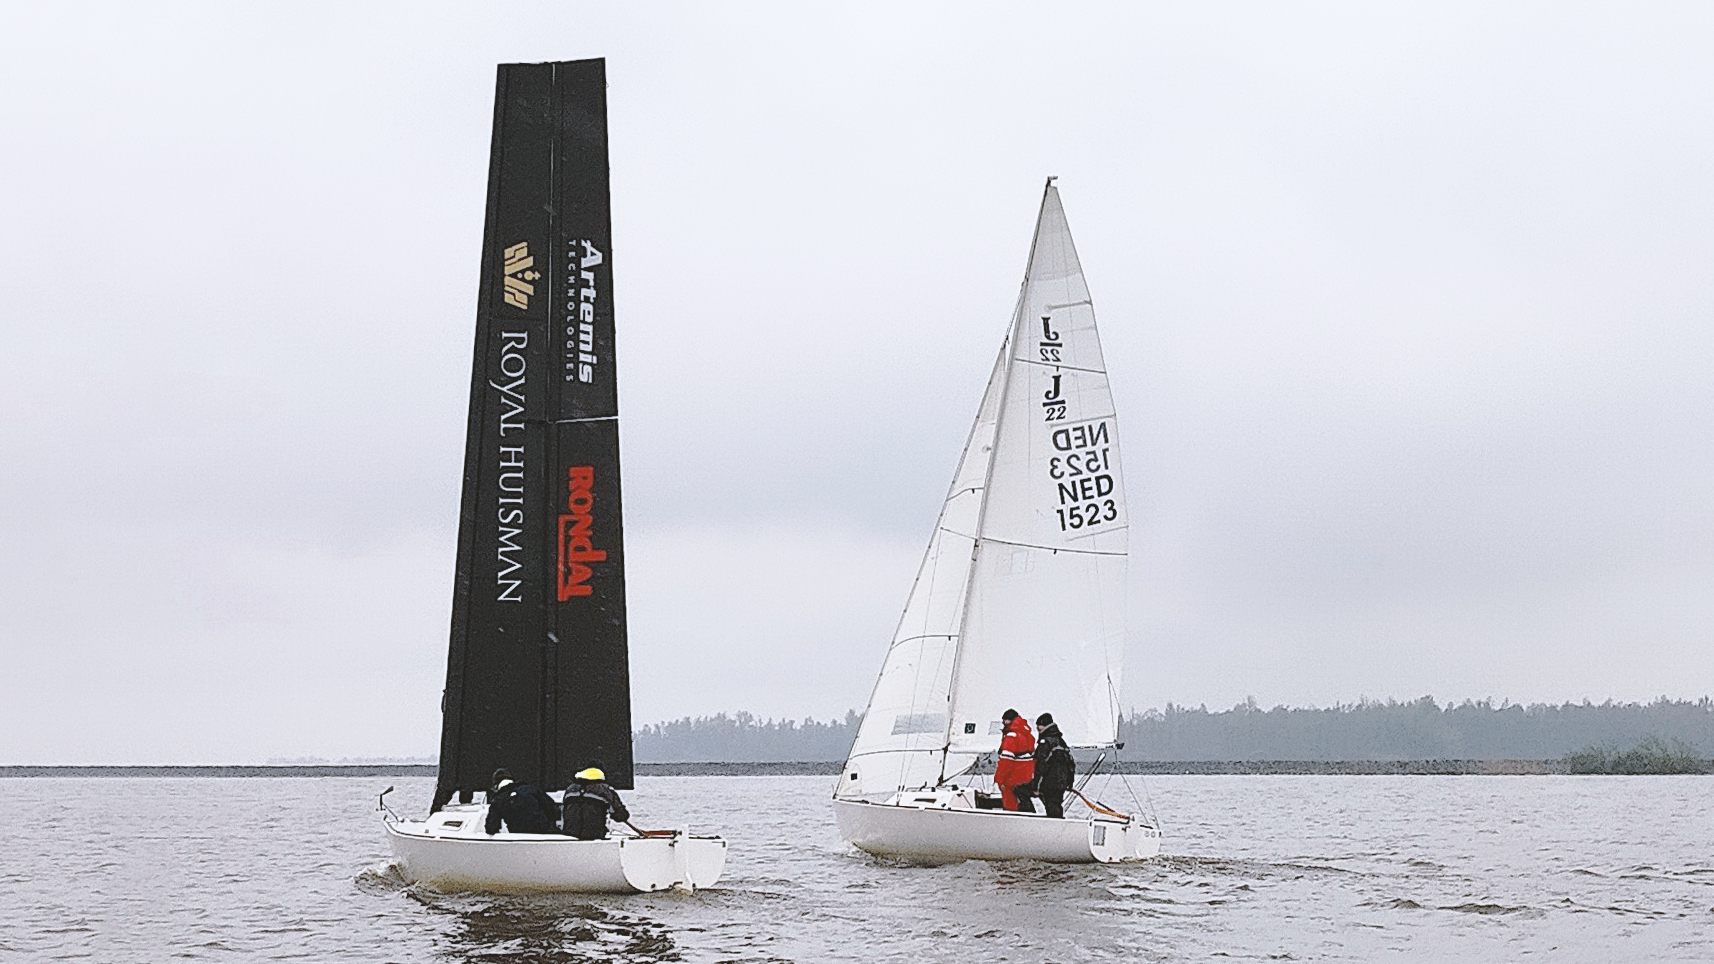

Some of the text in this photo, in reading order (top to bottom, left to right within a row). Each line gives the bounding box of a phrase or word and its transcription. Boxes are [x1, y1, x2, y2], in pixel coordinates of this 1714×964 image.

[565, 239, 577, 382] TECHNOLOGIES
[579, 239, 602, 384] Artemis
[1044, 374, 1061, 400] J
[1045, 406, 1066, 421] 22
[1058, 474, 1114, 505] NED
[497, 446, 524, 603] HUISMAN
[1056, 499, 1118, 532] 1523
